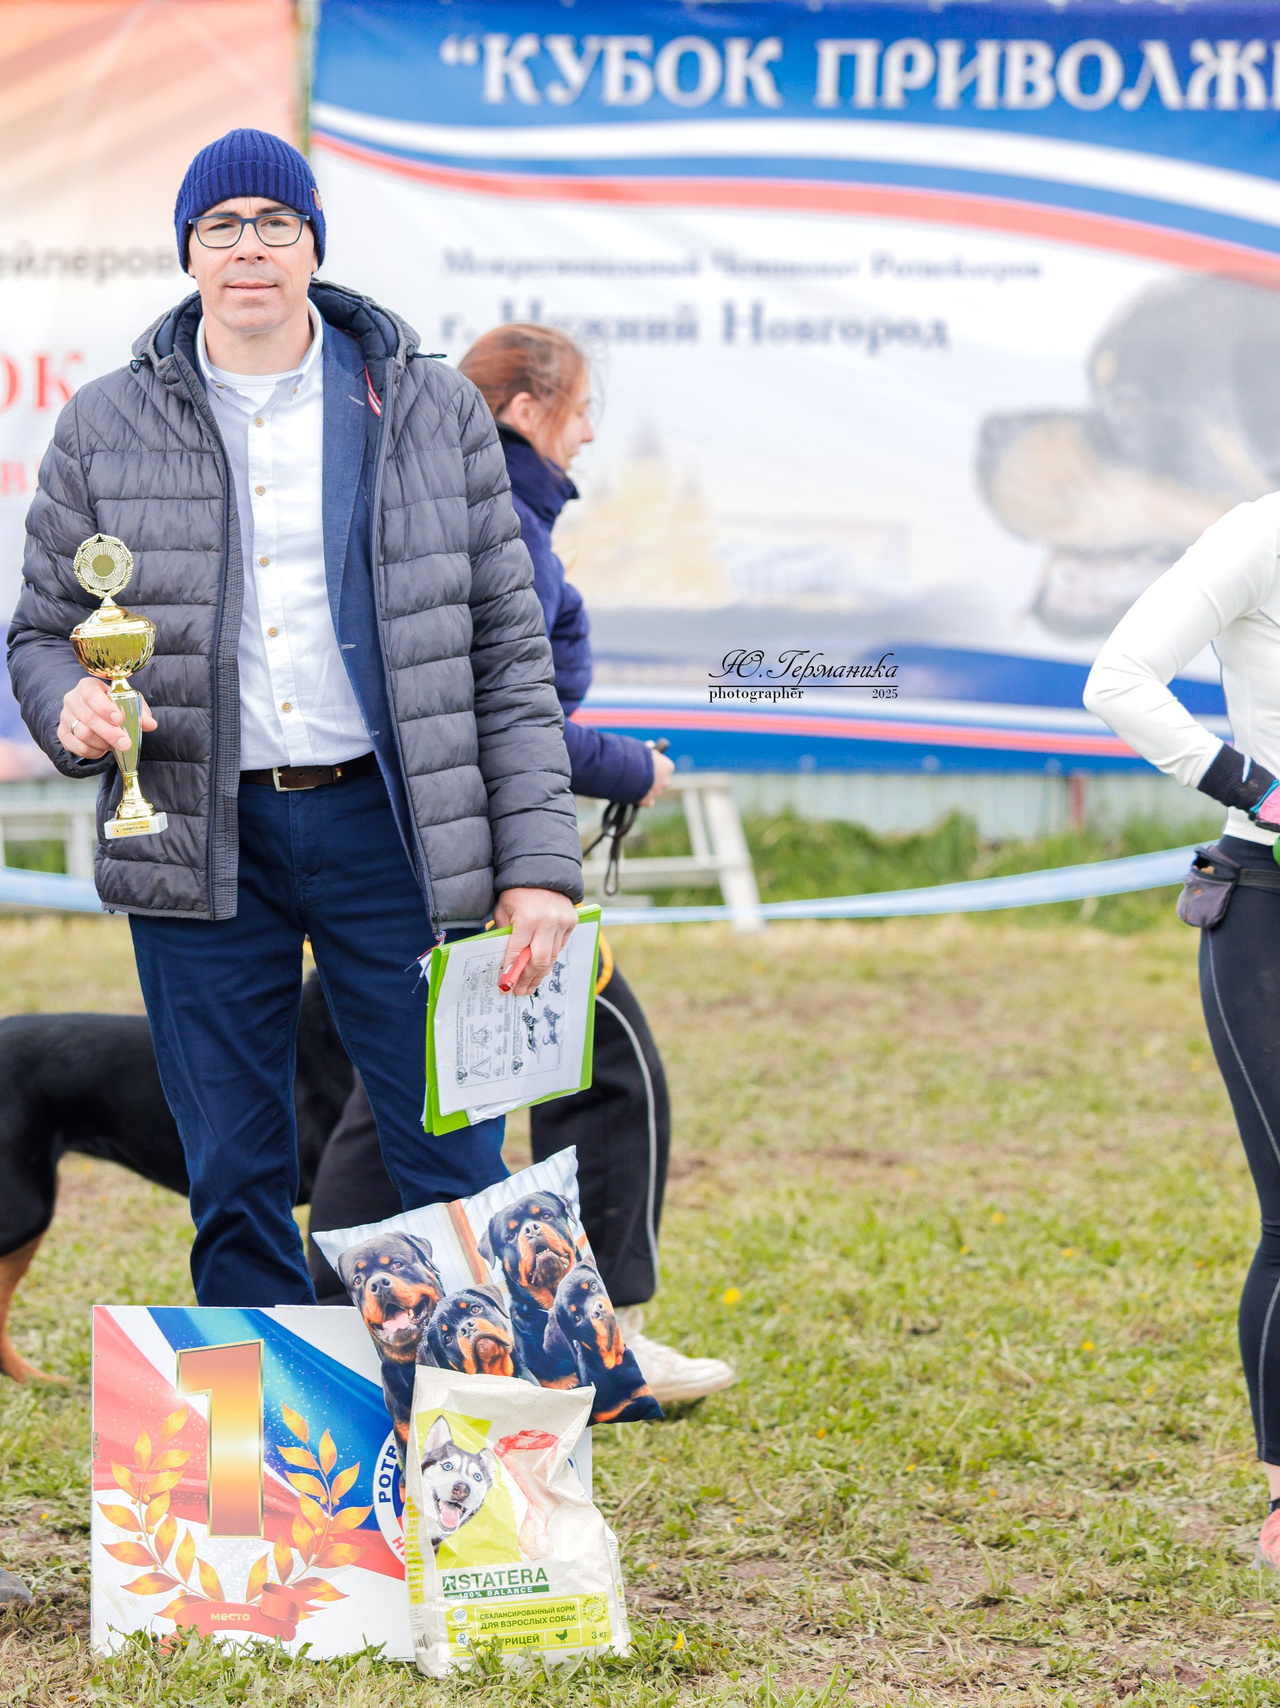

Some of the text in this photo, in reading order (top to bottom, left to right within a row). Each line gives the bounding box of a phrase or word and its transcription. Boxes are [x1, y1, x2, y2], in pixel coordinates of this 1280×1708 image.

[812, 37, 1280, 112] ПРИВОЛЖ
[722, 299, 950, 356] Новгород
[176, 1338, 264, 1538] 1
[458, 1567, 549, 1591] STATERA
[458, 1587, 534, 1599] 100% BALANCE
[211, 1613, 250, 1621] место
[479, 1605, 576, 1620] СБАЛАНСИРОВАННЫЙ КОРМ
[480, 1621, 499, 1630] ДЛЯ
[500, 1616, 548, 1628] ВЗРОСЛЫХ
[549, 1613, 577, 1623] СОБАК
[591, 1631, 608, 1640] 3 кг
